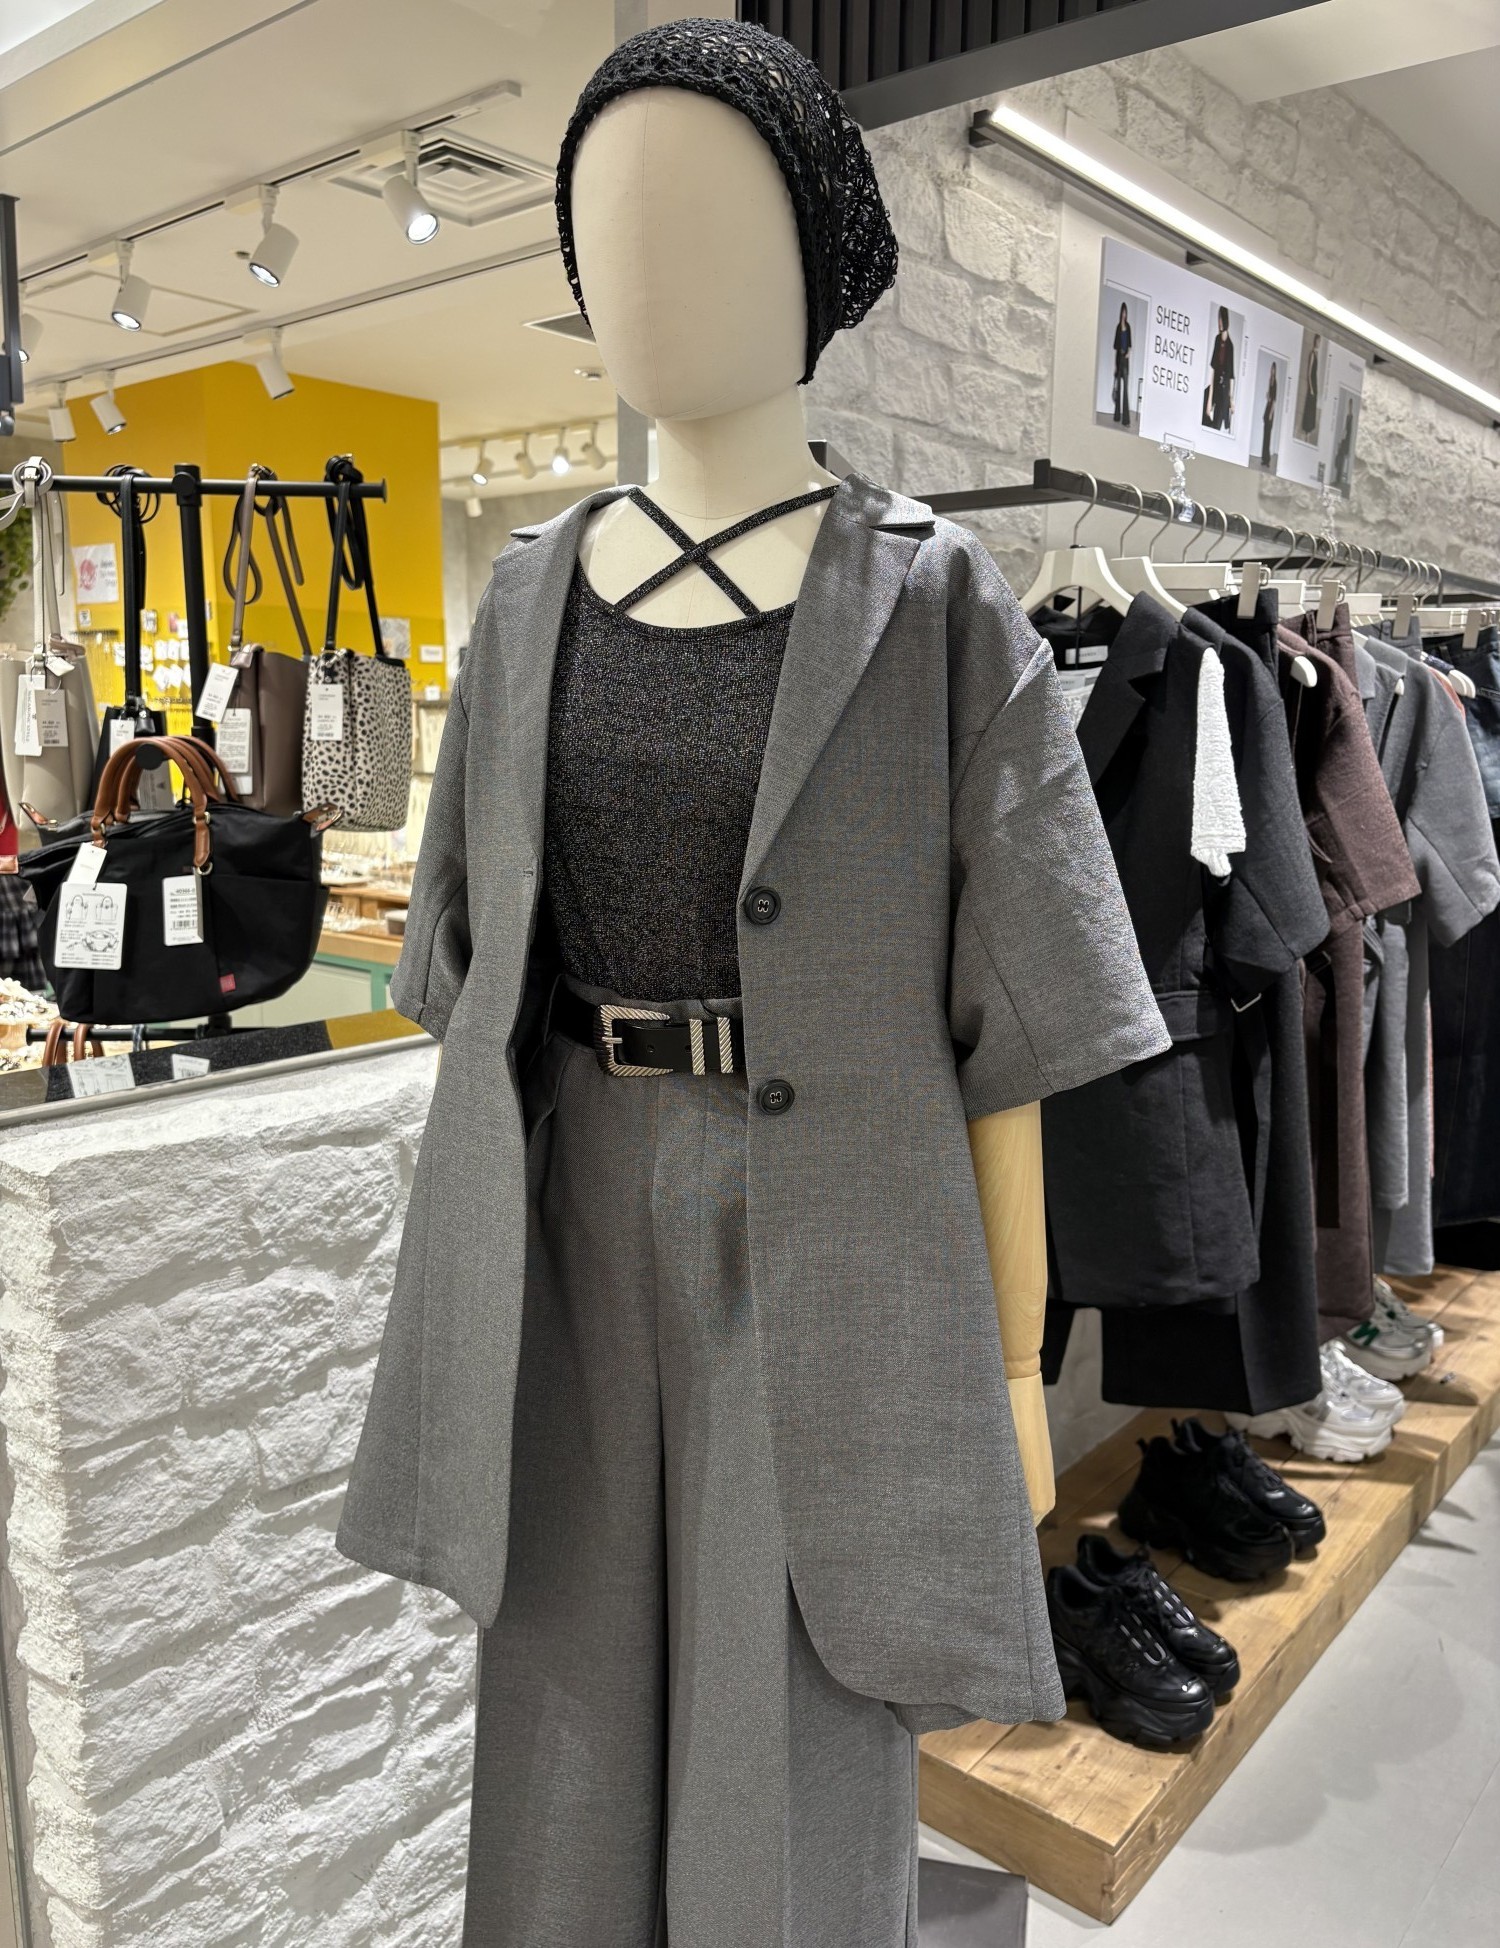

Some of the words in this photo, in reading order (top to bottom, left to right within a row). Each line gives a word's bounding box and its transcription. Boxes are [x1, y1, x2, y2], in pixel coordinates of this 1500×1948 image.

[1156, 305, 1190, 335] SHEER
[1154, 335, 1195, 366] BASKET
[1152, 365, 1190, 394] SERIES
